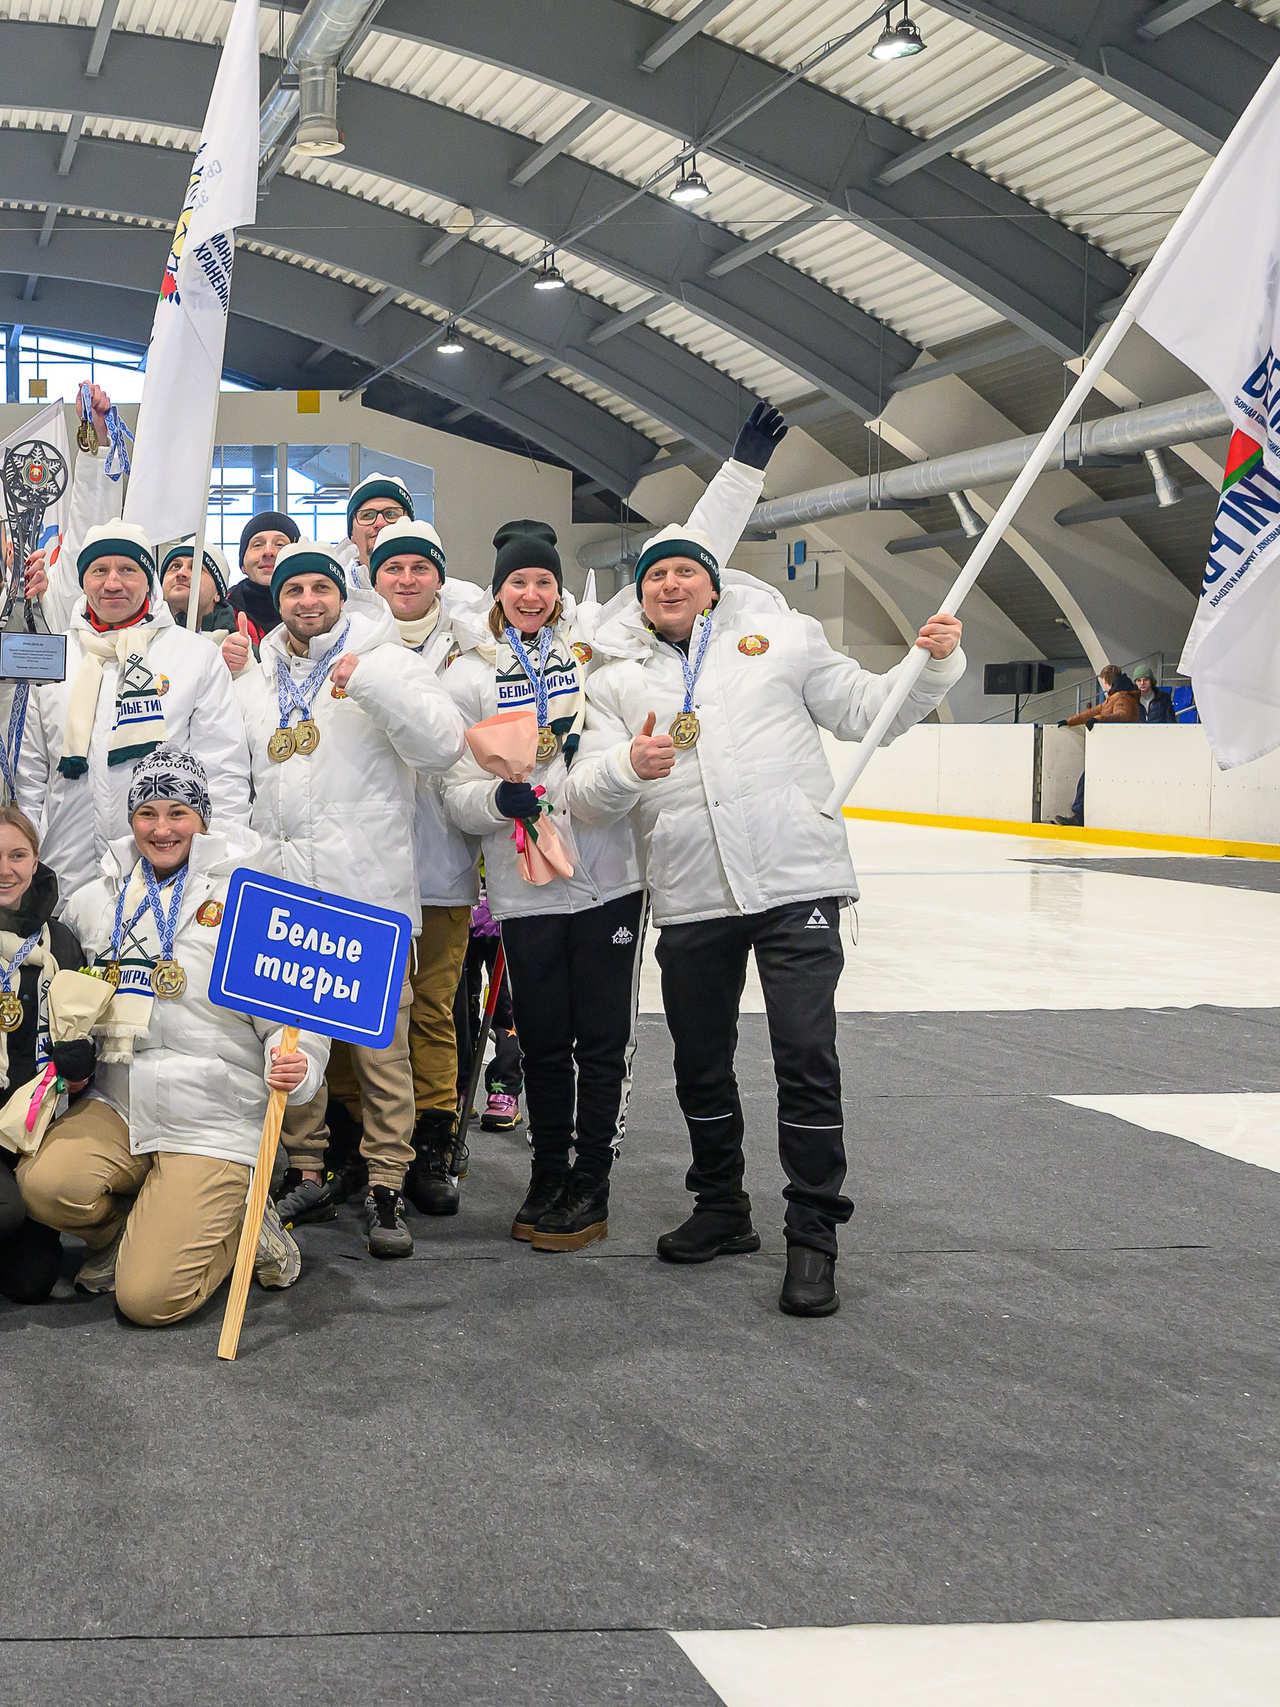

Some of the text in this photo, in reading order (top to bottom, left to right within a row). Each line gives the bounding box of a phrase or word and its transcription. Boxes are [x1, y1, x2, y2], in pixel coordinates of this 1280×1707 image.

[498, 672, 576, 699] БЕЛЫ ИГРЫ
[266, 906, 363, 963] Белые
[254, 952, 361, 1004] тигры
